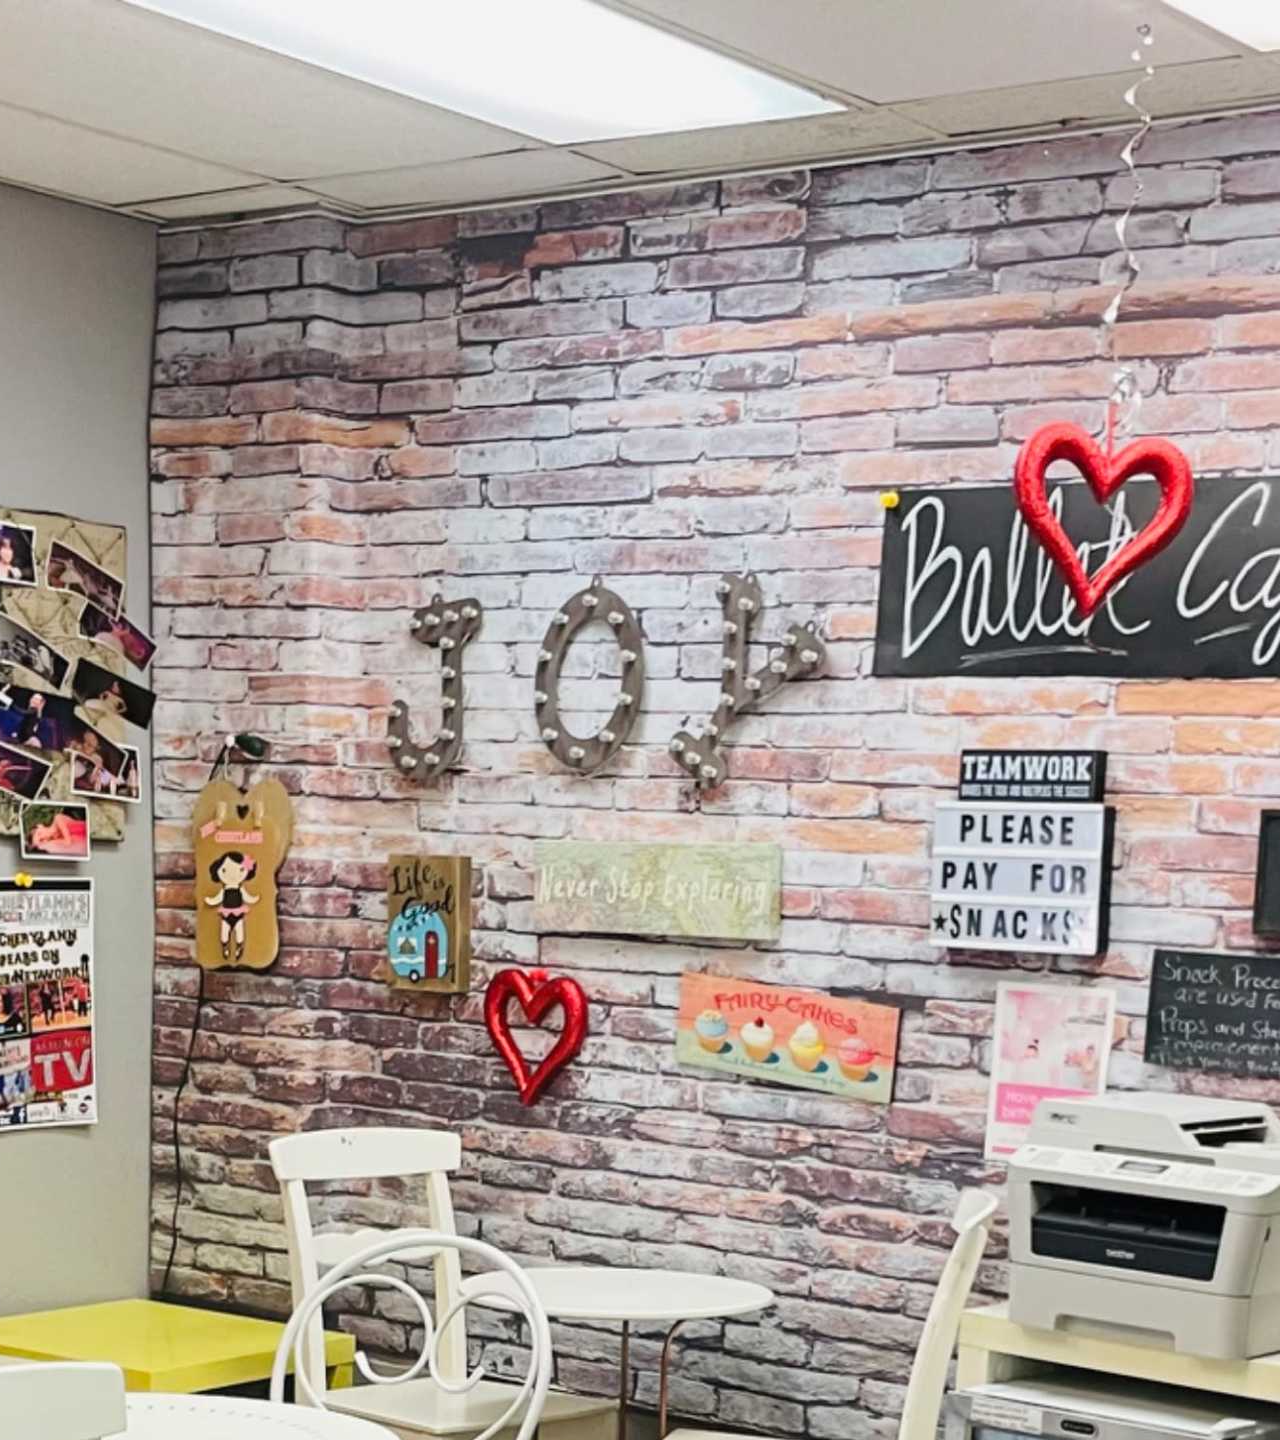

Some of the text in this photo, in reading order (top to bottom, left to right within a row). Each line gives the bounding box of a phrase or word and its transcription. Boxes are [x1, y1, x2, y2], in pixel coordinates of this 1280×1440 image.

[388, 574, 827, 792] JOY
[962, 755, 1093, 782] TEAMWORK
[960, 814, 1075, 846] PLEASE
[538, 864, 770, 916] Never Stop Exploring
[941, 861, 1086, 895] PAY FOR
[1162, 956, 1222, 985] Snack
[1174, 987, 1209, 1005] are
[784, 996, 859, 1035] CAKES
[1160, 1005, 1208, 1040] Props
[33, 1047, 91, 1088] TV
